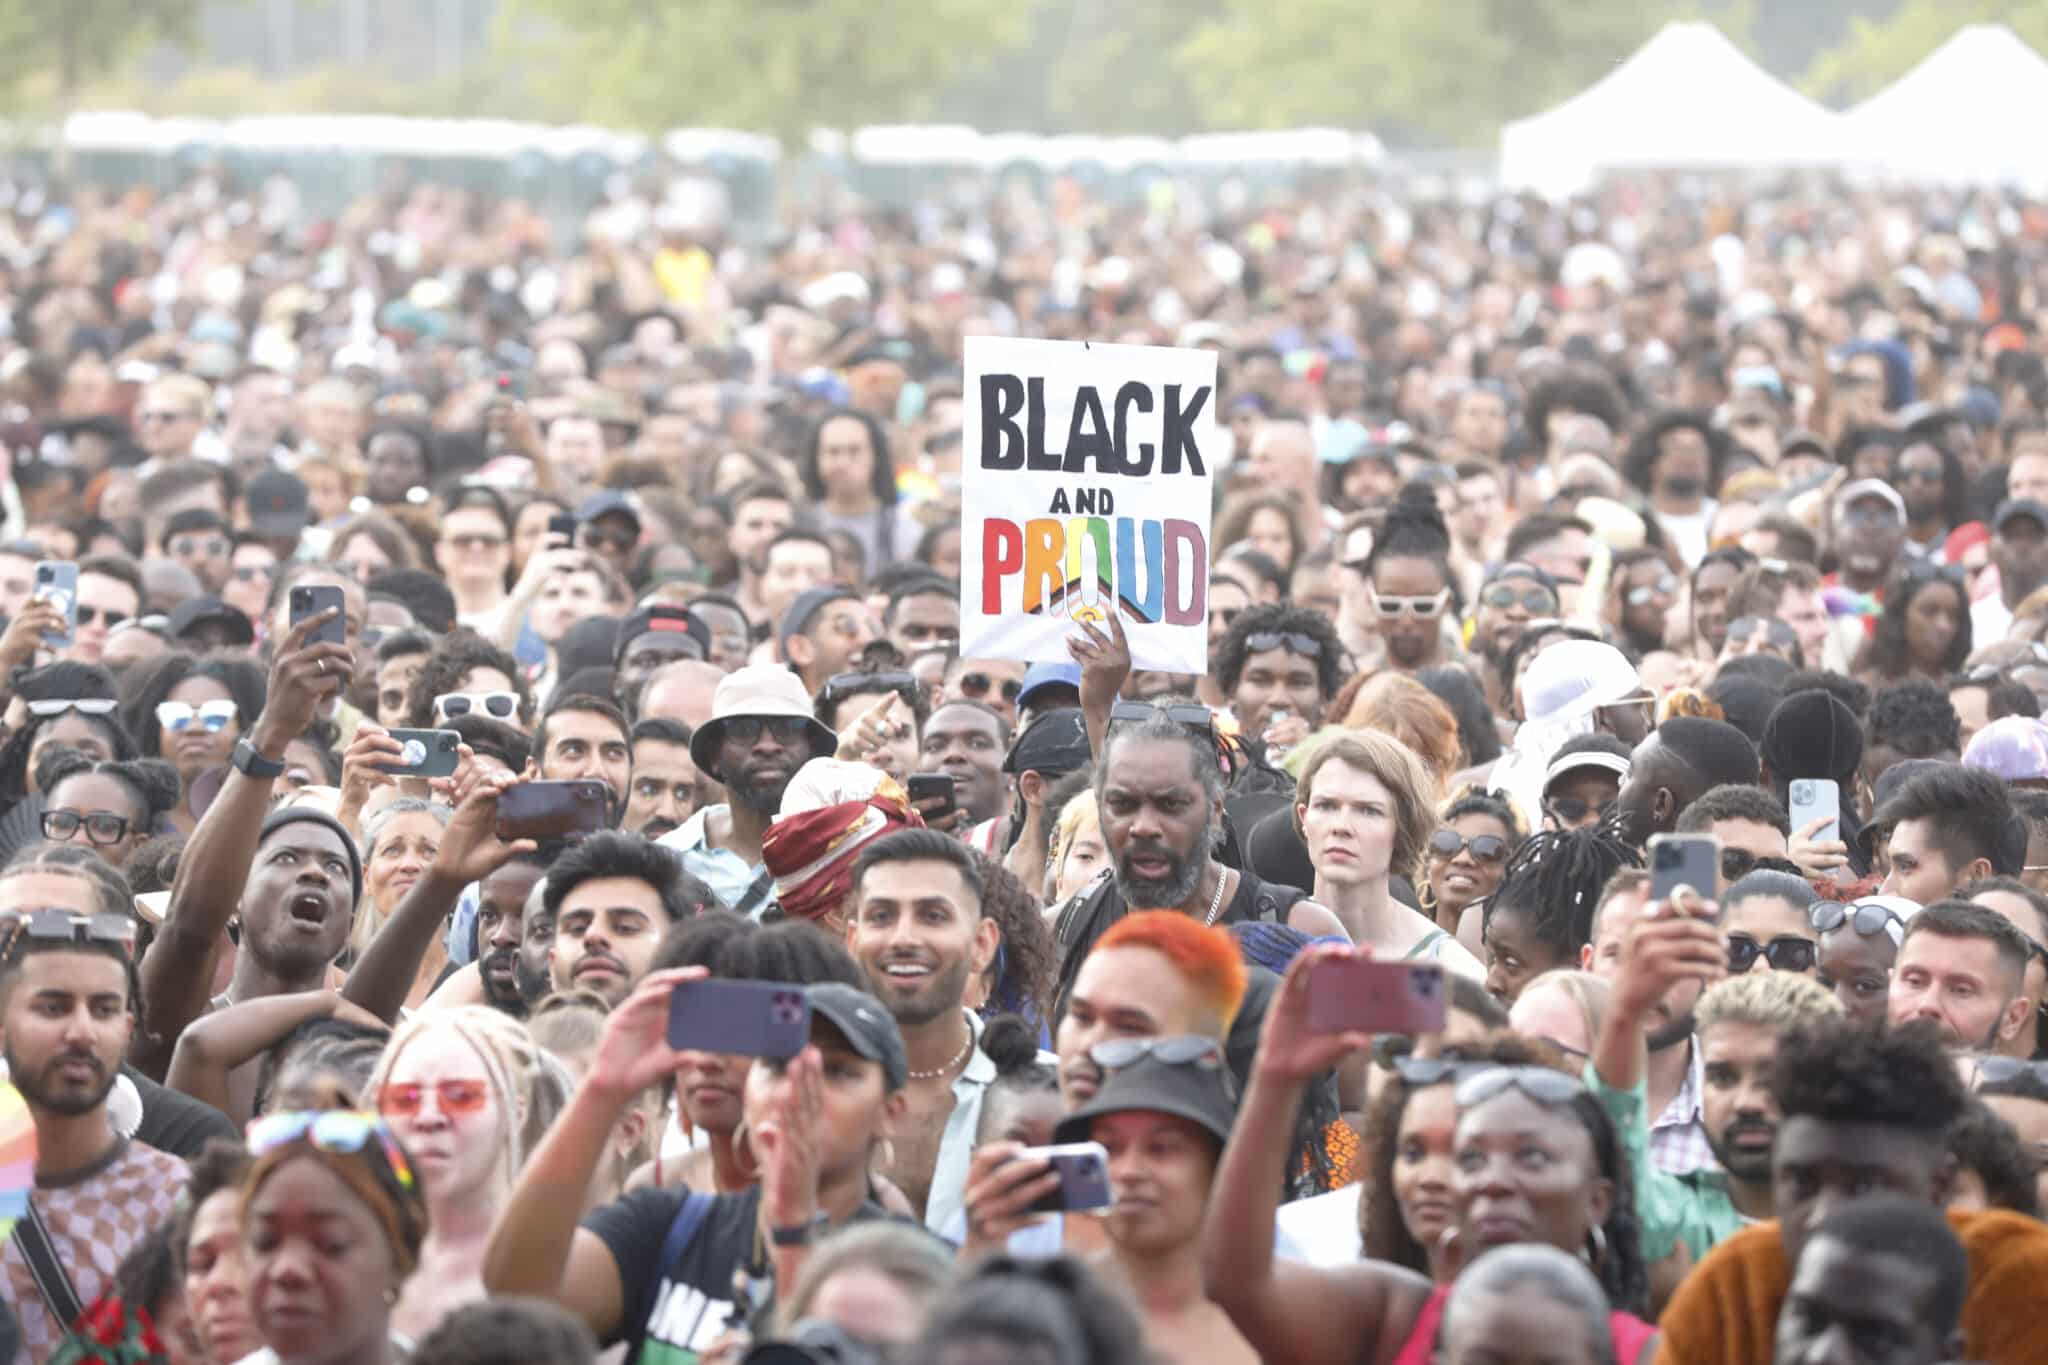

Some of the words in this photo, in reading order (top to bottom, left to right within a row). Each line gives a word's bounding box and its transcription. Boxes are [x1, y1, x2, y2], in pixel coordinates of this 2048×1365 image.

[980, 373, 1212, 477] BLACK
[1049, 487, 1114, 515] AND
[982, 517, 1206, 626] PROUD
